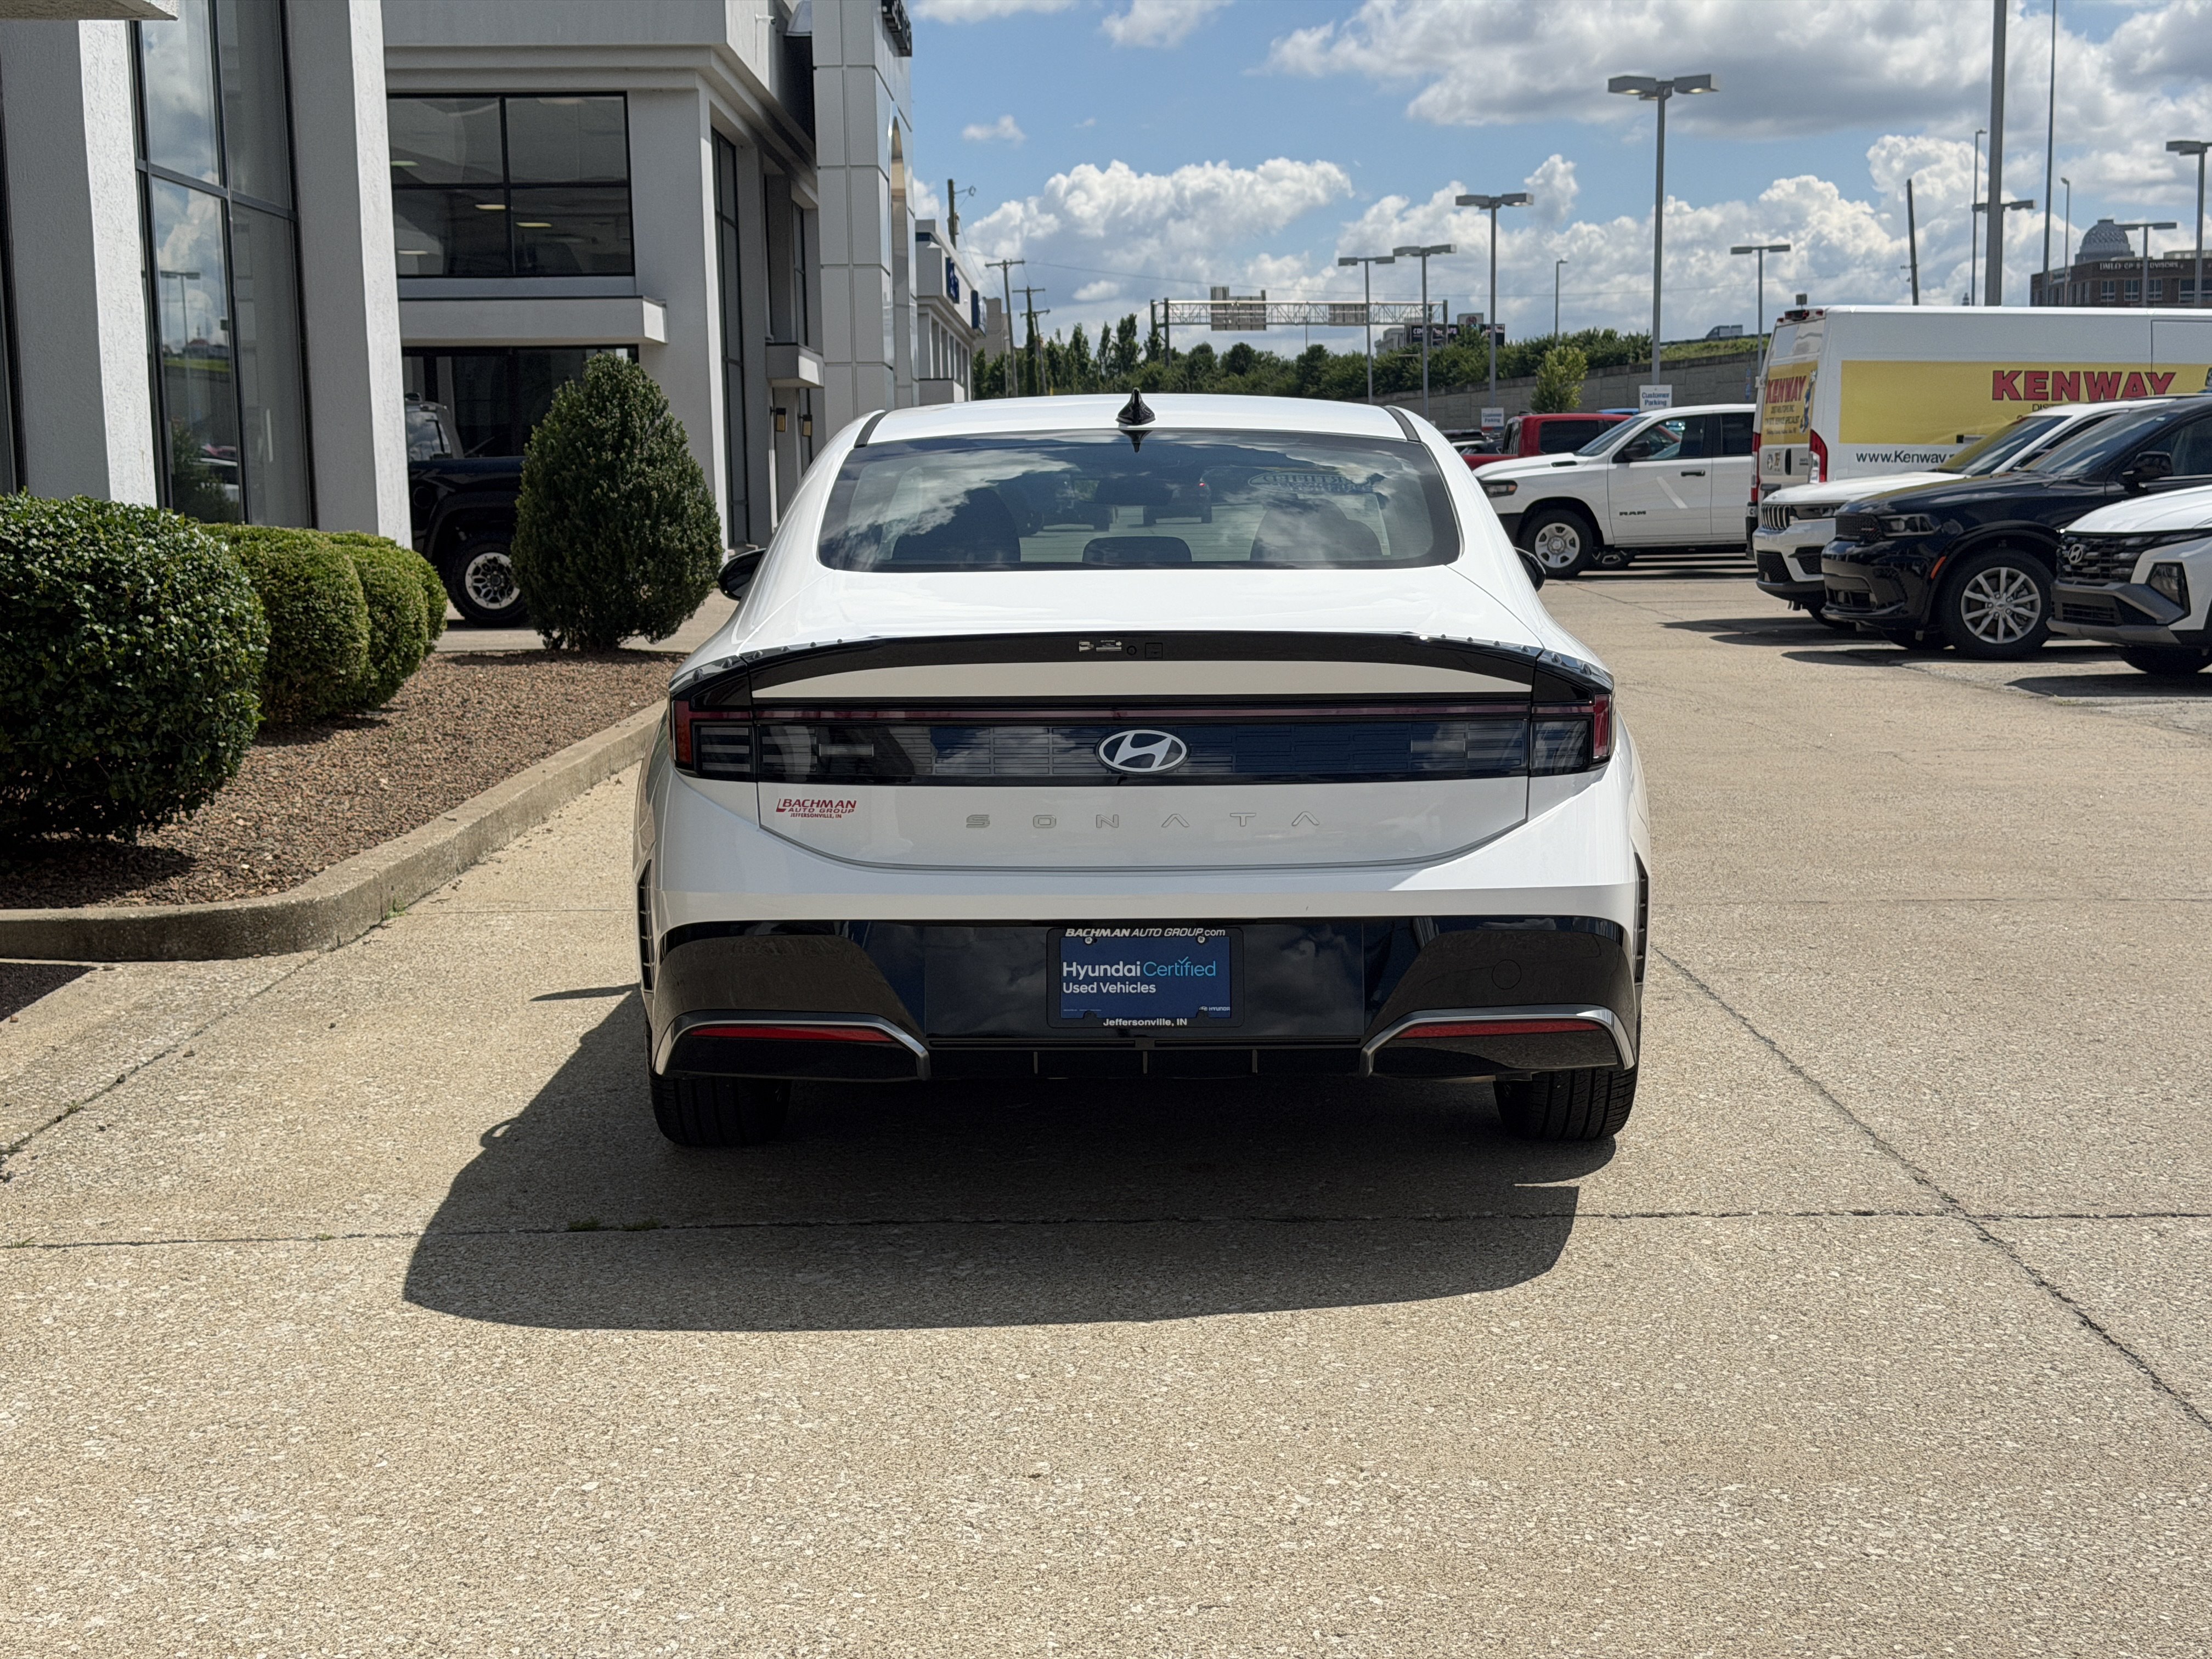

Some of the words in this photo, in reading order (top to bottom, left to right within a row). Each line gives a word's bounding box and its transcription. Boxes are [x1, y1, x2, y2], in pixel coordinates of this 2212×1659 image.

[1765, 375, 1807, 404] KENWAY
[1992, 370, 2176, 401] KENWAY
[1856, 450, 1955, 464] www.Kenway
[782, 799, 857, 809] BACHMAN
[966, 811, 1320, 828] SONATA
[1065, 928, 1130, 937] BACHMAN
[1131, 928, 1162, 937] AUTO
[1062, 961, 1141, 980] Hyundai
[1143, 957, 1216, 977] Certified
[1063, 982, 1097, 994] Used
[1099, 981, 1156, 994] Vehicles
[1103, 1018, 1174, 1027] Jeffersonville,
